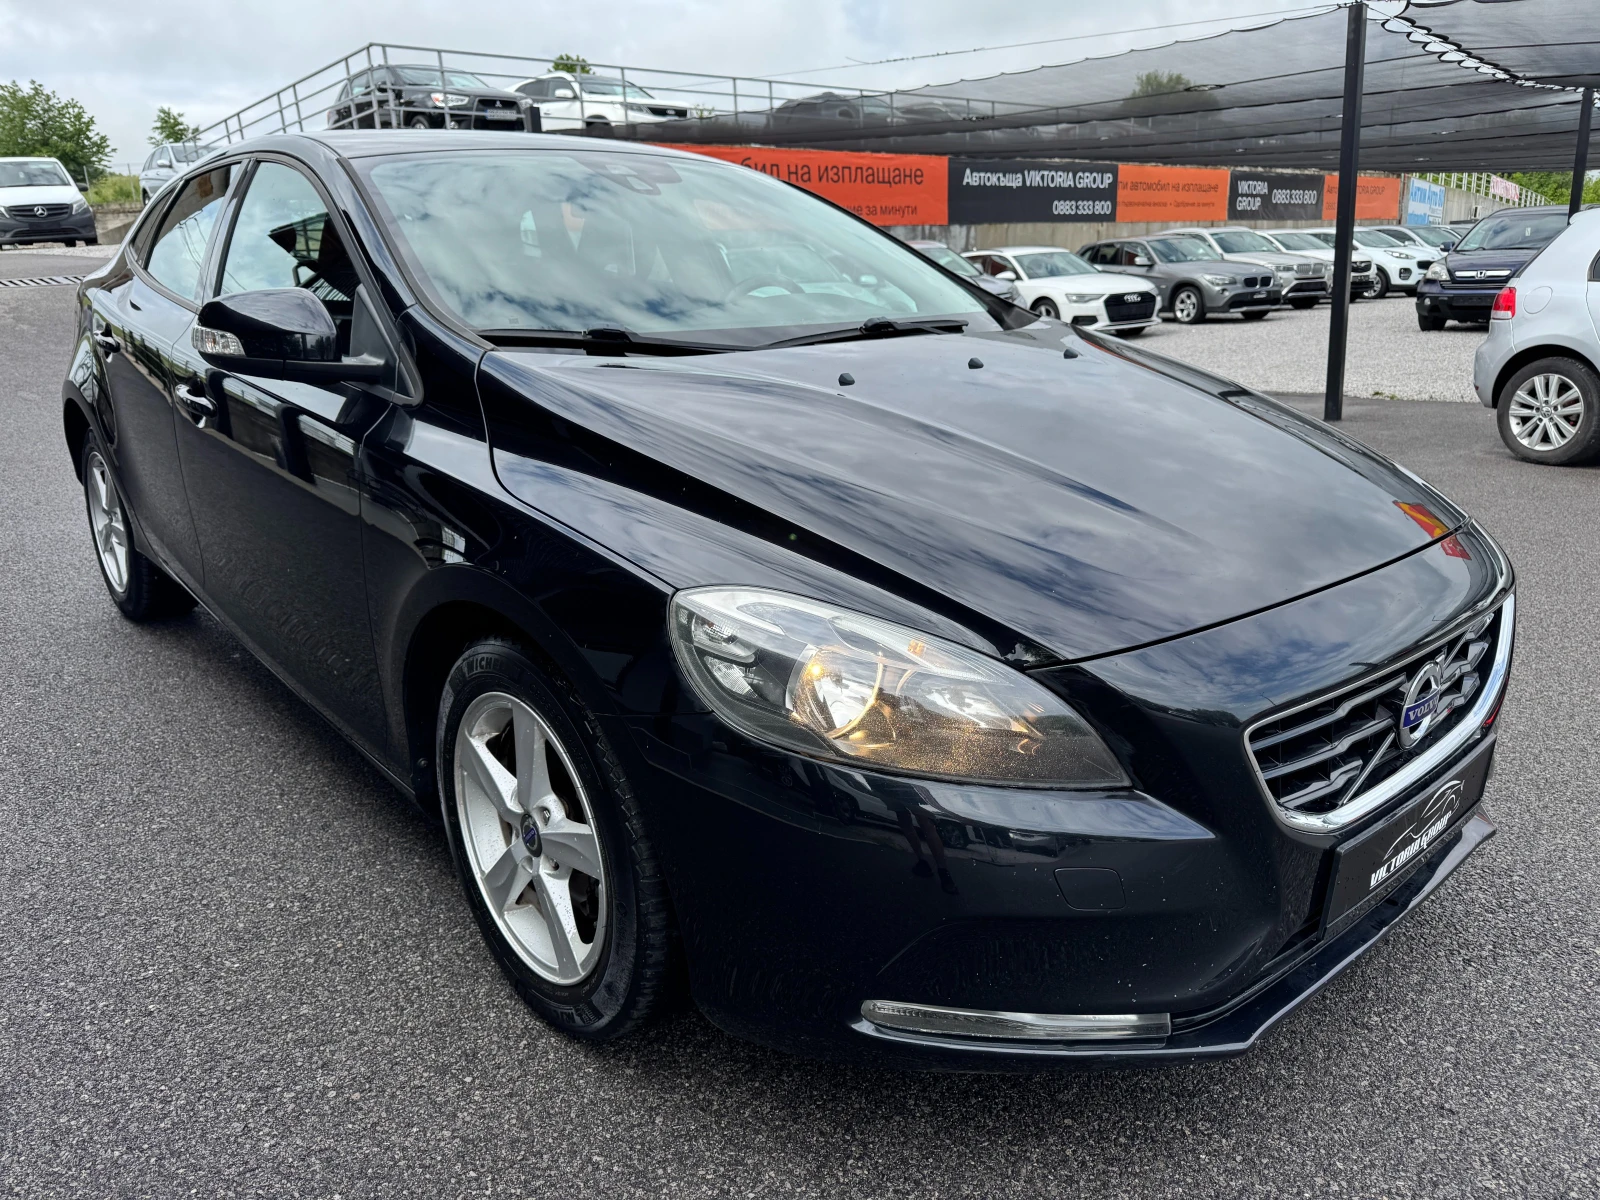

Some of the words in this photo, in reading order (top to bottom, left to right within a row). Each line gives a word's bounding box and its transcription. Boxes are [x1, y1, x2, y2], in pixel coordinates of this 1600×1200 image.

[787, 163, 811, 183] на
[818, 164, 924, 188] изплащане
[963, 168, 1023, 189] Автокъща
[1024, 169, 1075, 189] VIKTORIA
[1076, 171, 1113, 189] GROUP
[1129, 179, 1170, 192] автомобил
[1237, 180, 1268, 195] VIKTORIA
[1236, 197, 1261, 211] GROUP
[1272, 189, 1289, 204] 0883
[1290, 189, 1303, 204] 333
[865, 205, 878, 216] за
[880, 205, 917, 218] минути
[1052, 200, 1076, 215] 0883
[1076, 200, 1093, 215] 333
[1094, 201, 1112, 214] 800
